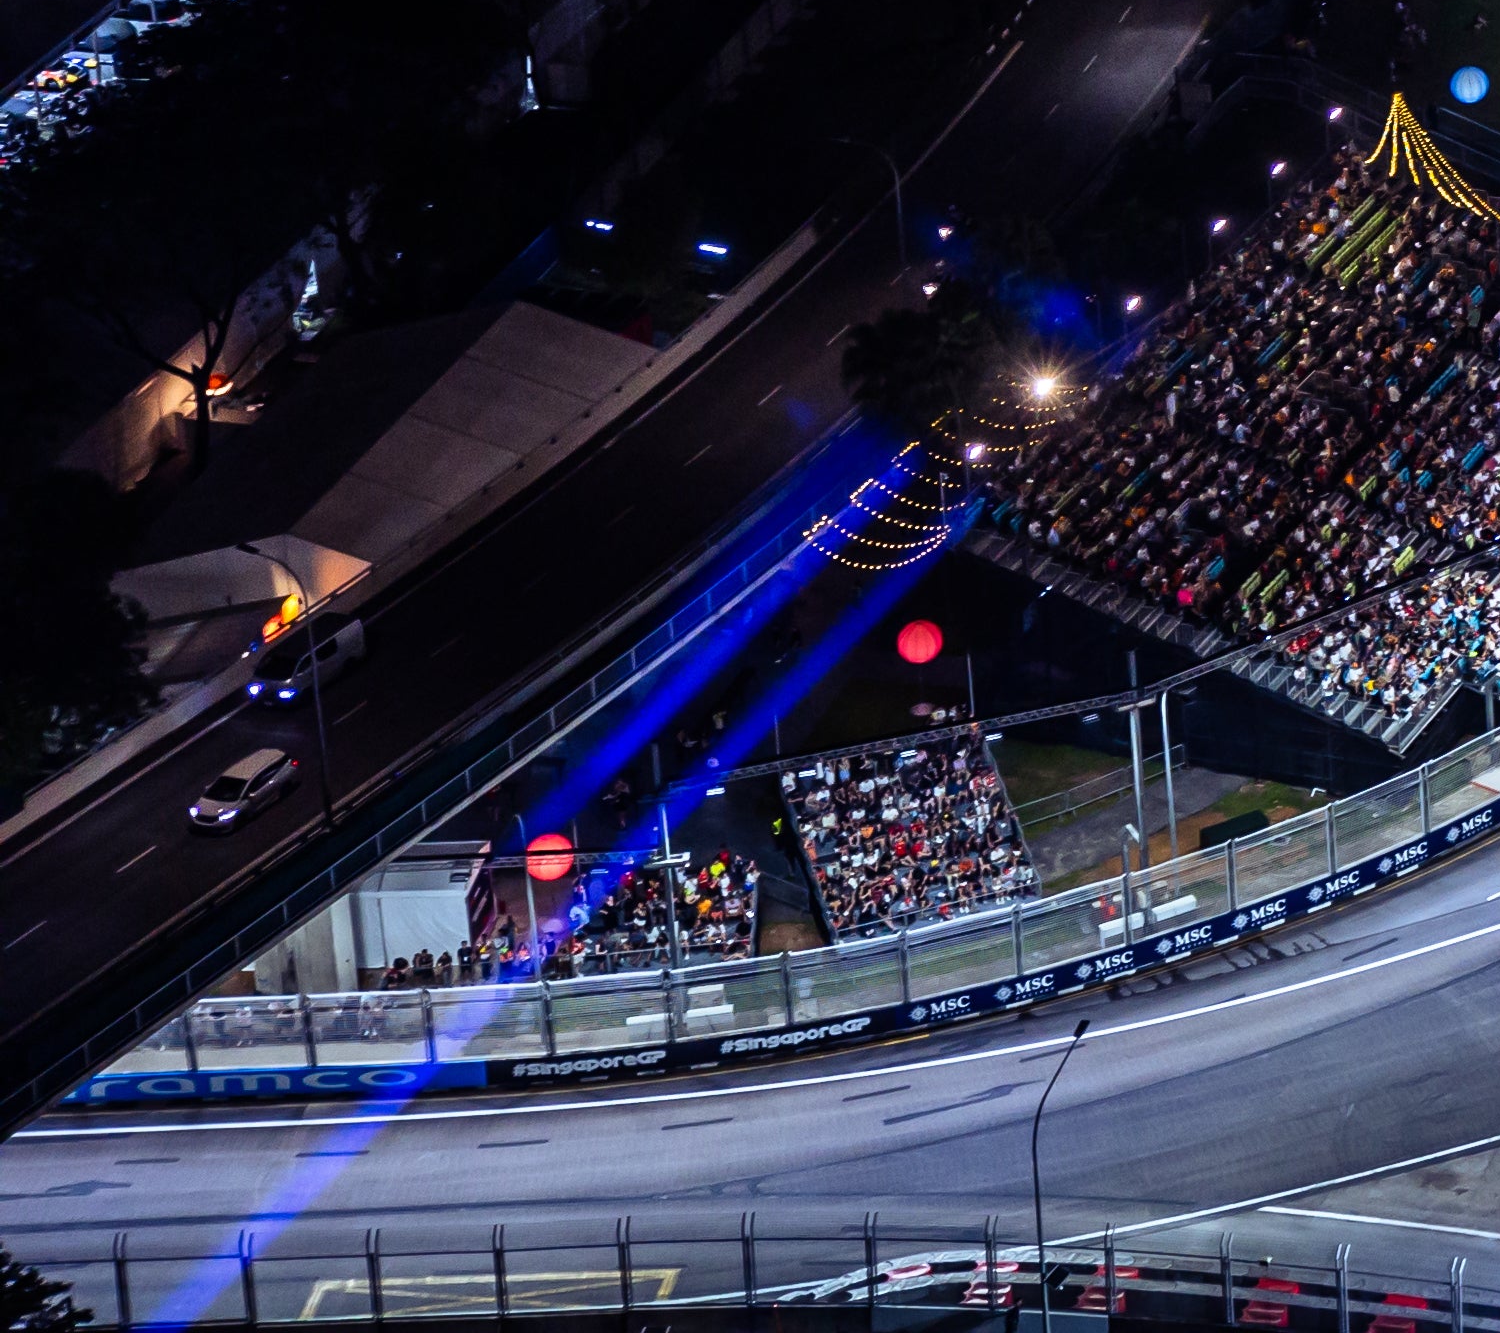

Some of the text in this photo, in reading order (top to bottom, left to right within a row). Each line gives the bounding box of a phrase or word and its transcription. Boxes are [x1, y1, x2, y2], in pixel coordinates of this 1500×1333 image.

[1460, 809, 1493, 834] MSC
[1394, 842, 1428, 866] MSC
[1324, 870, 1360, 894] MSC
[1250, 899, 1287, 921] MSC
[1174, 925, 1213, 947] MSC
[1095, 951, 1134, 972] MSC
[1015, 974, 1055, 995] MSC
[930, 996, 971, 1014] MSC
[62, 1069, 418, 1100] ramco
